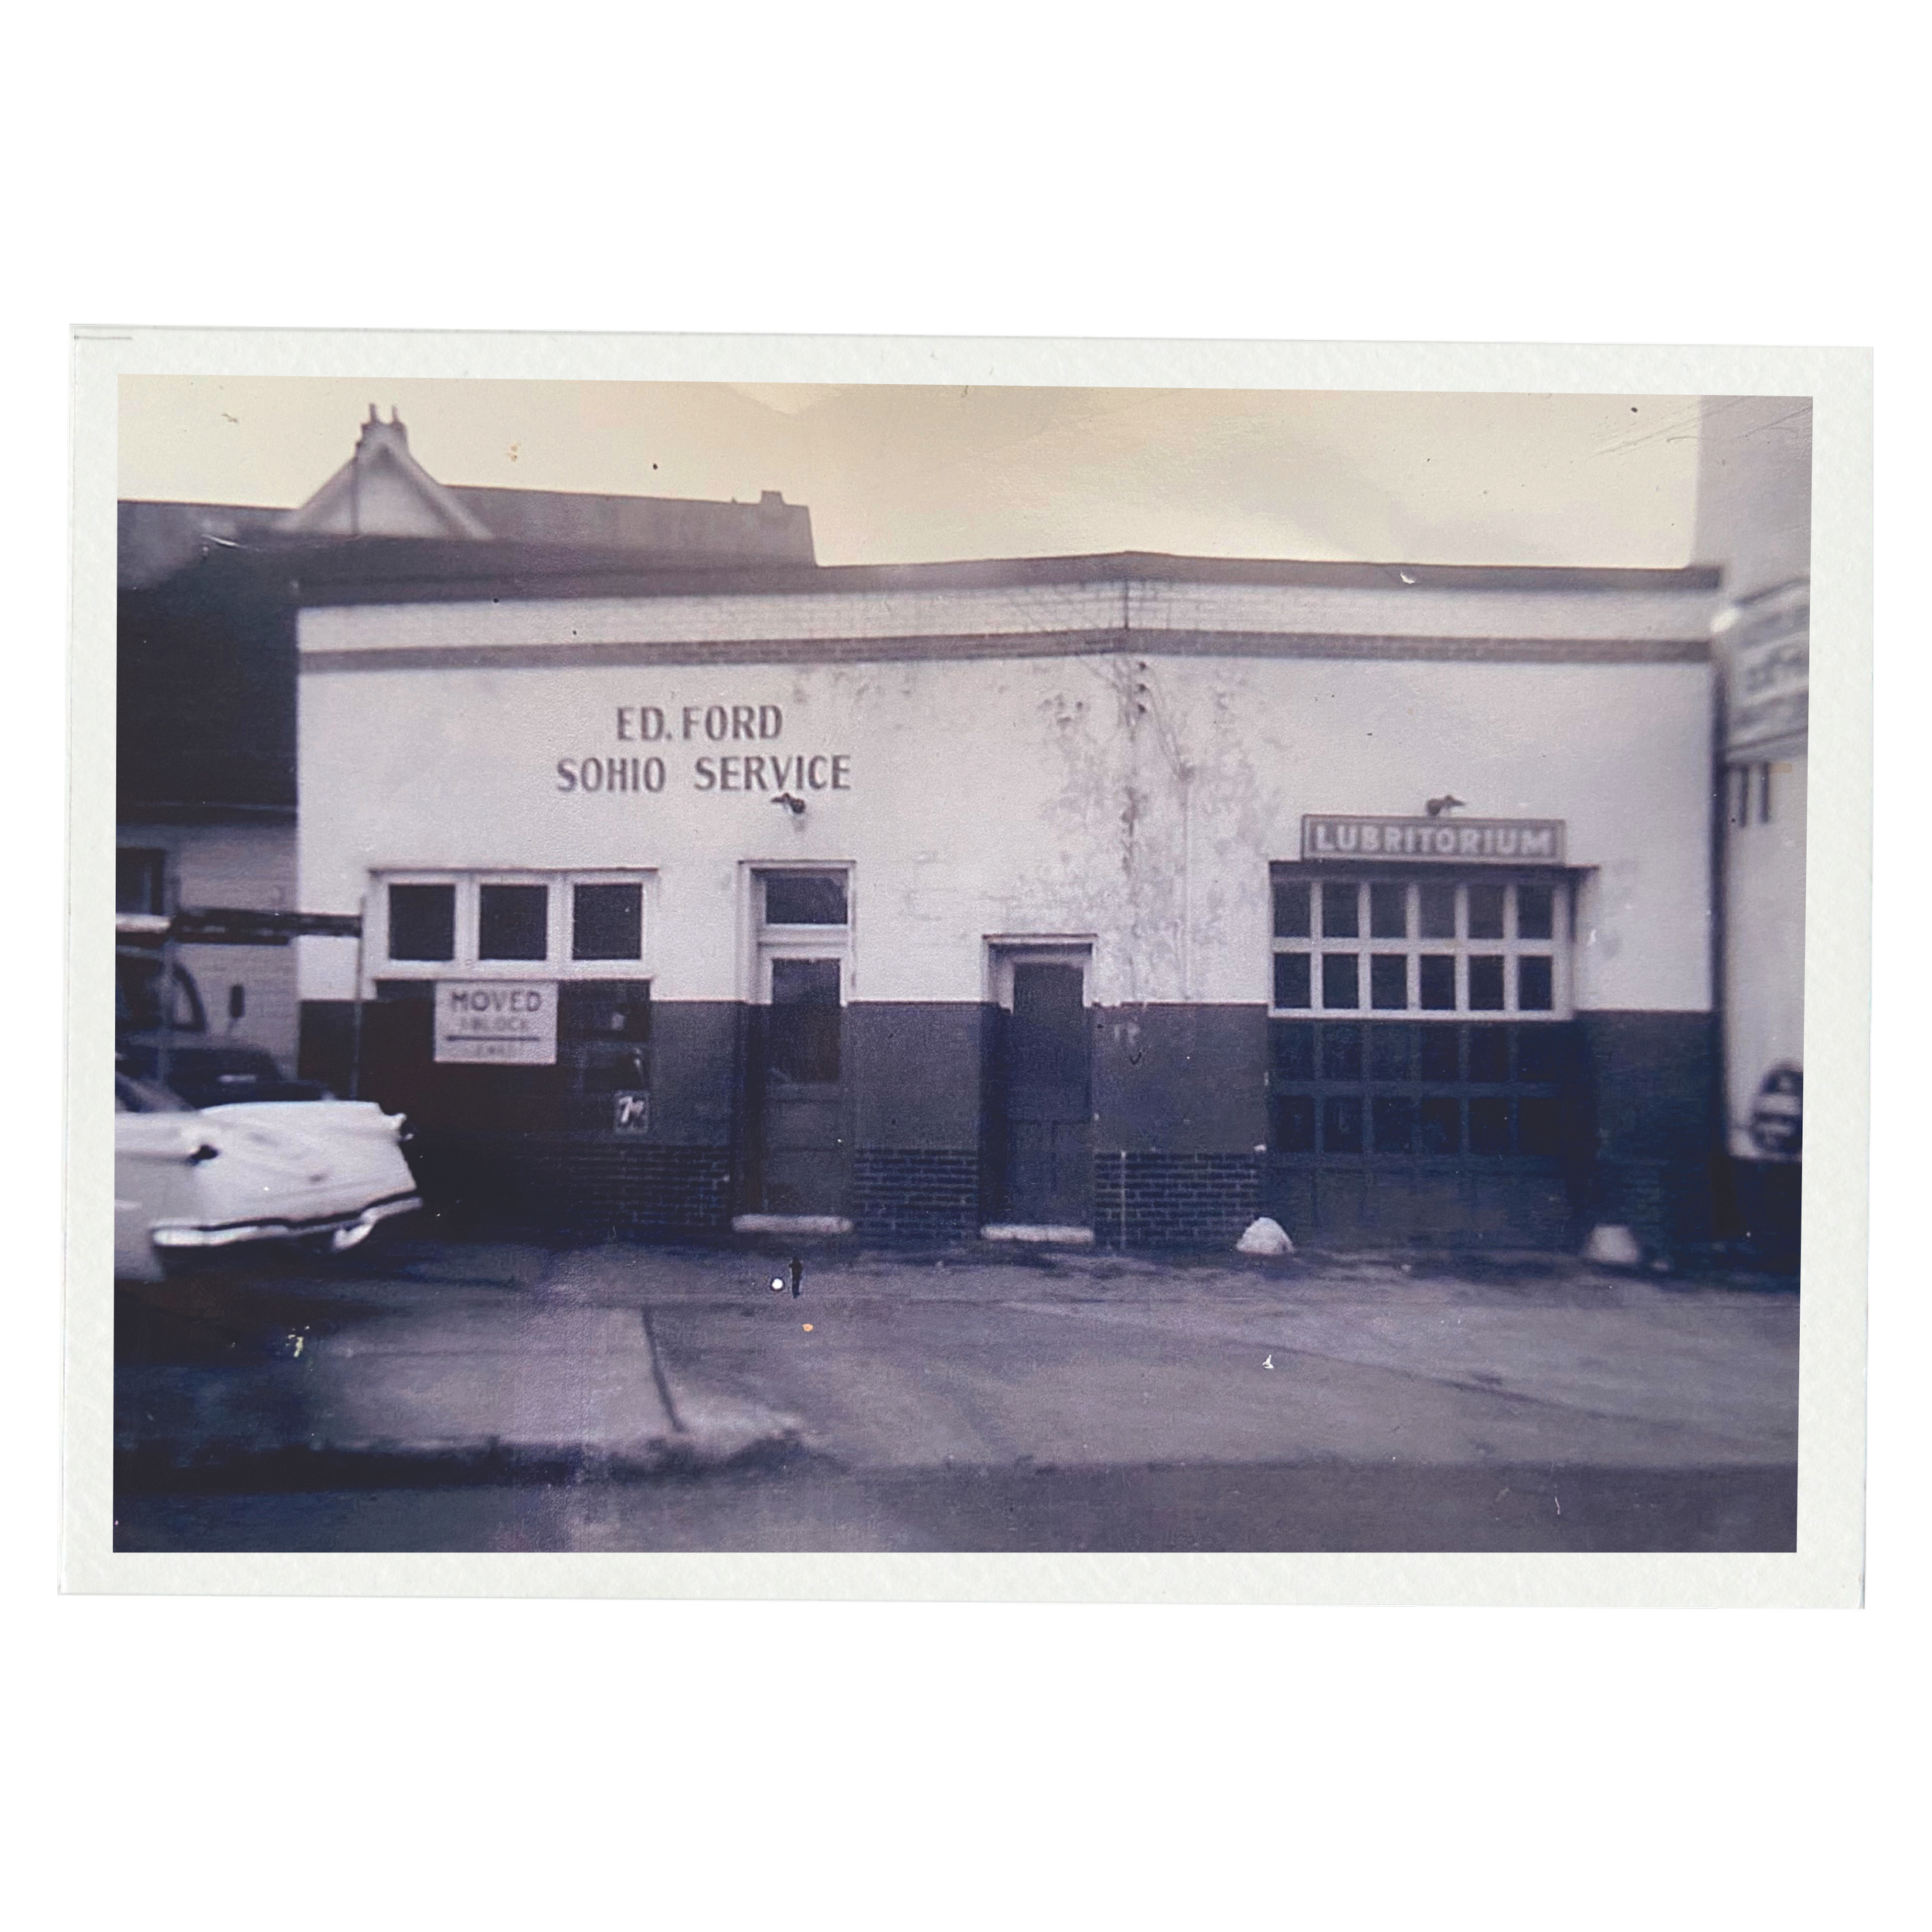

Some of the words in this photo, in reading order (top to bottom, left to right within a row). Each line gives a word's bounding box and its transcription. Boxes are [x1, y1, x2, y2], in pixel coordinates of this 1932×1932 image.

[682, 704, 783, 741] FORD
[556, 757, 666, 793] SOHIO
[695, 754, 851, 792] SERVICE
[1316, 824, 1552, 855] LUBRITORIUM
[451, 989, 542, 1012] MOVED
